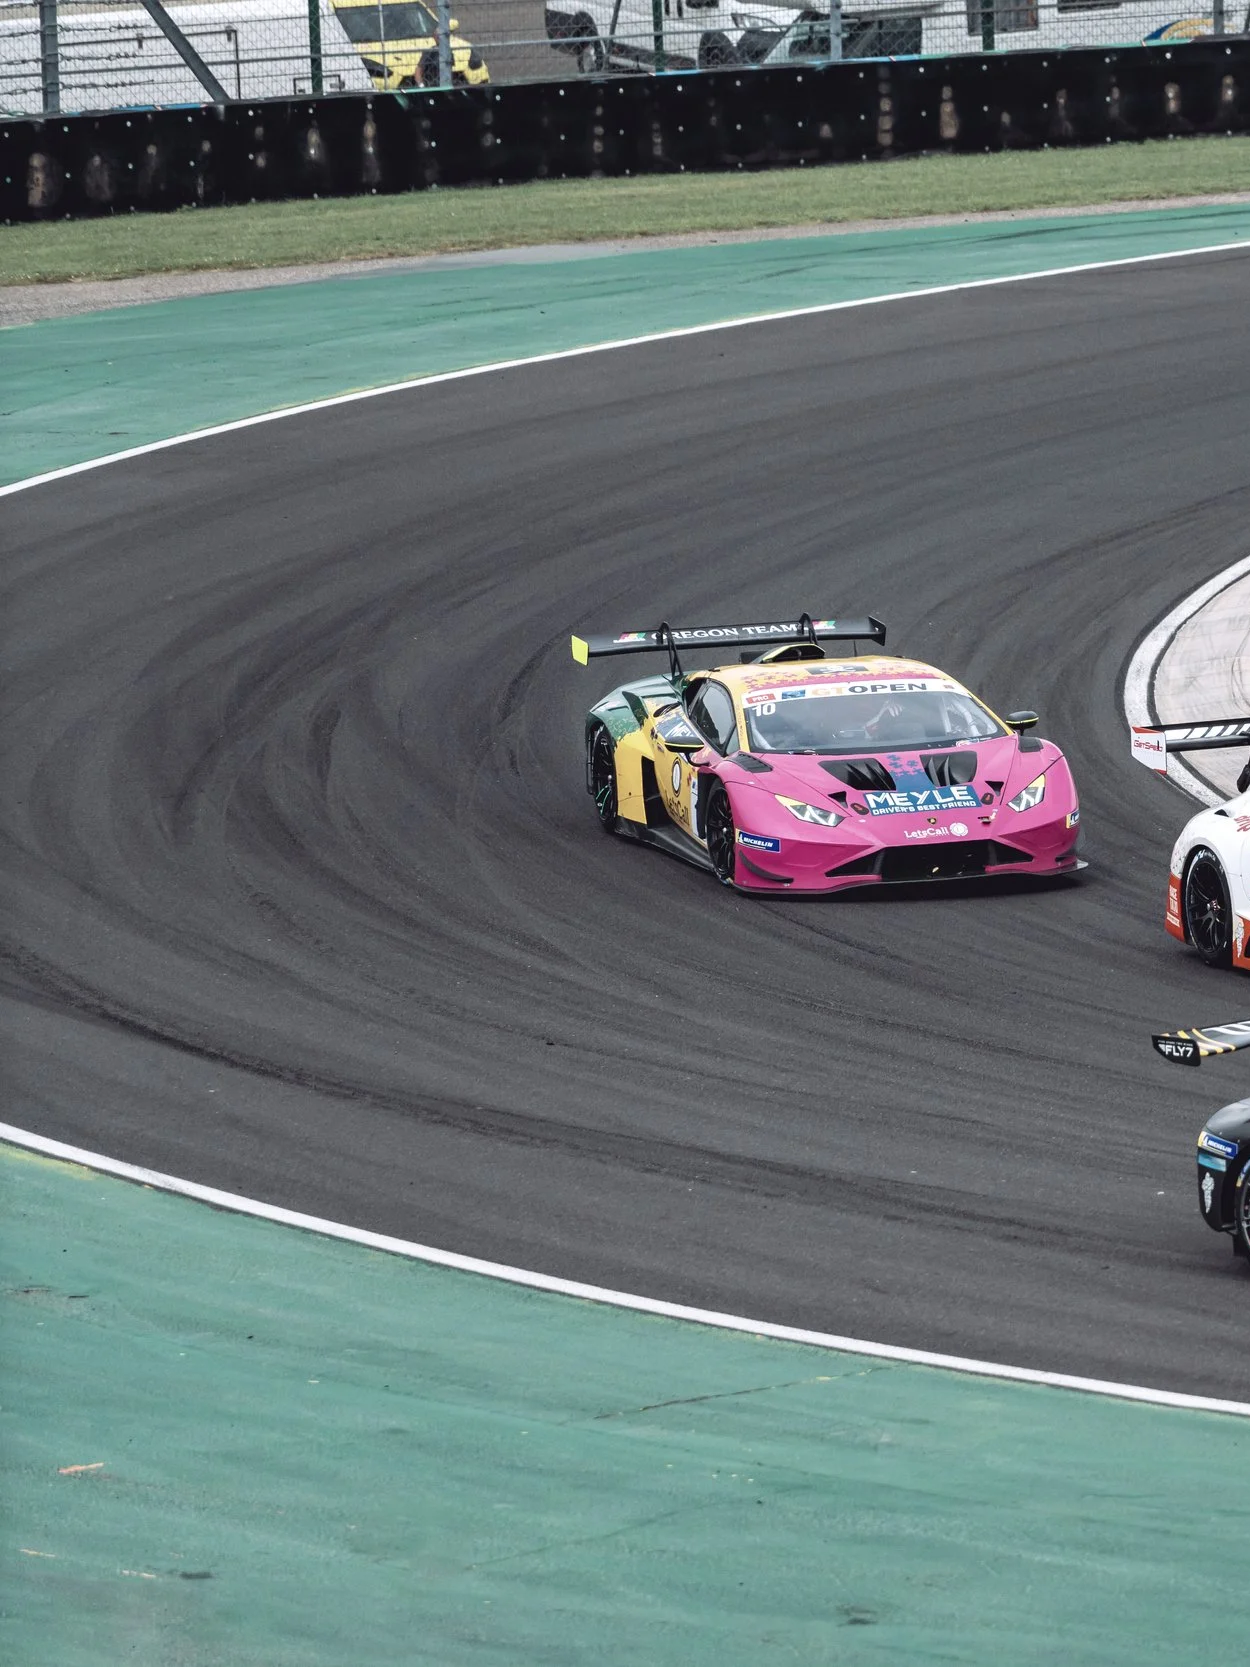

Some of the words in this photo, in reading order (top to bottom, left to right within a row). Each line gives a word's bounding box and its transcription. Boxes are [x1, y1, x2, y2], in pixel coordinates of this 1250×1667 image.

[744, 622, 799, 636] TEAM
[752, 694, 769, 702] PRO
[751, 703, 776, 717] 10
[866, 785, 974, 808] MEYLE
[872, 804, 915, 816] DRIVER'S
[917, 803, 941, 812] BEST
[942, 800, 977, 810] FRIEND
[904, 826, 949, 839] LetsCall
[743, 836, 774, 848] MICHELIN
[1164, 1044, 1194, 1058] FLY7
